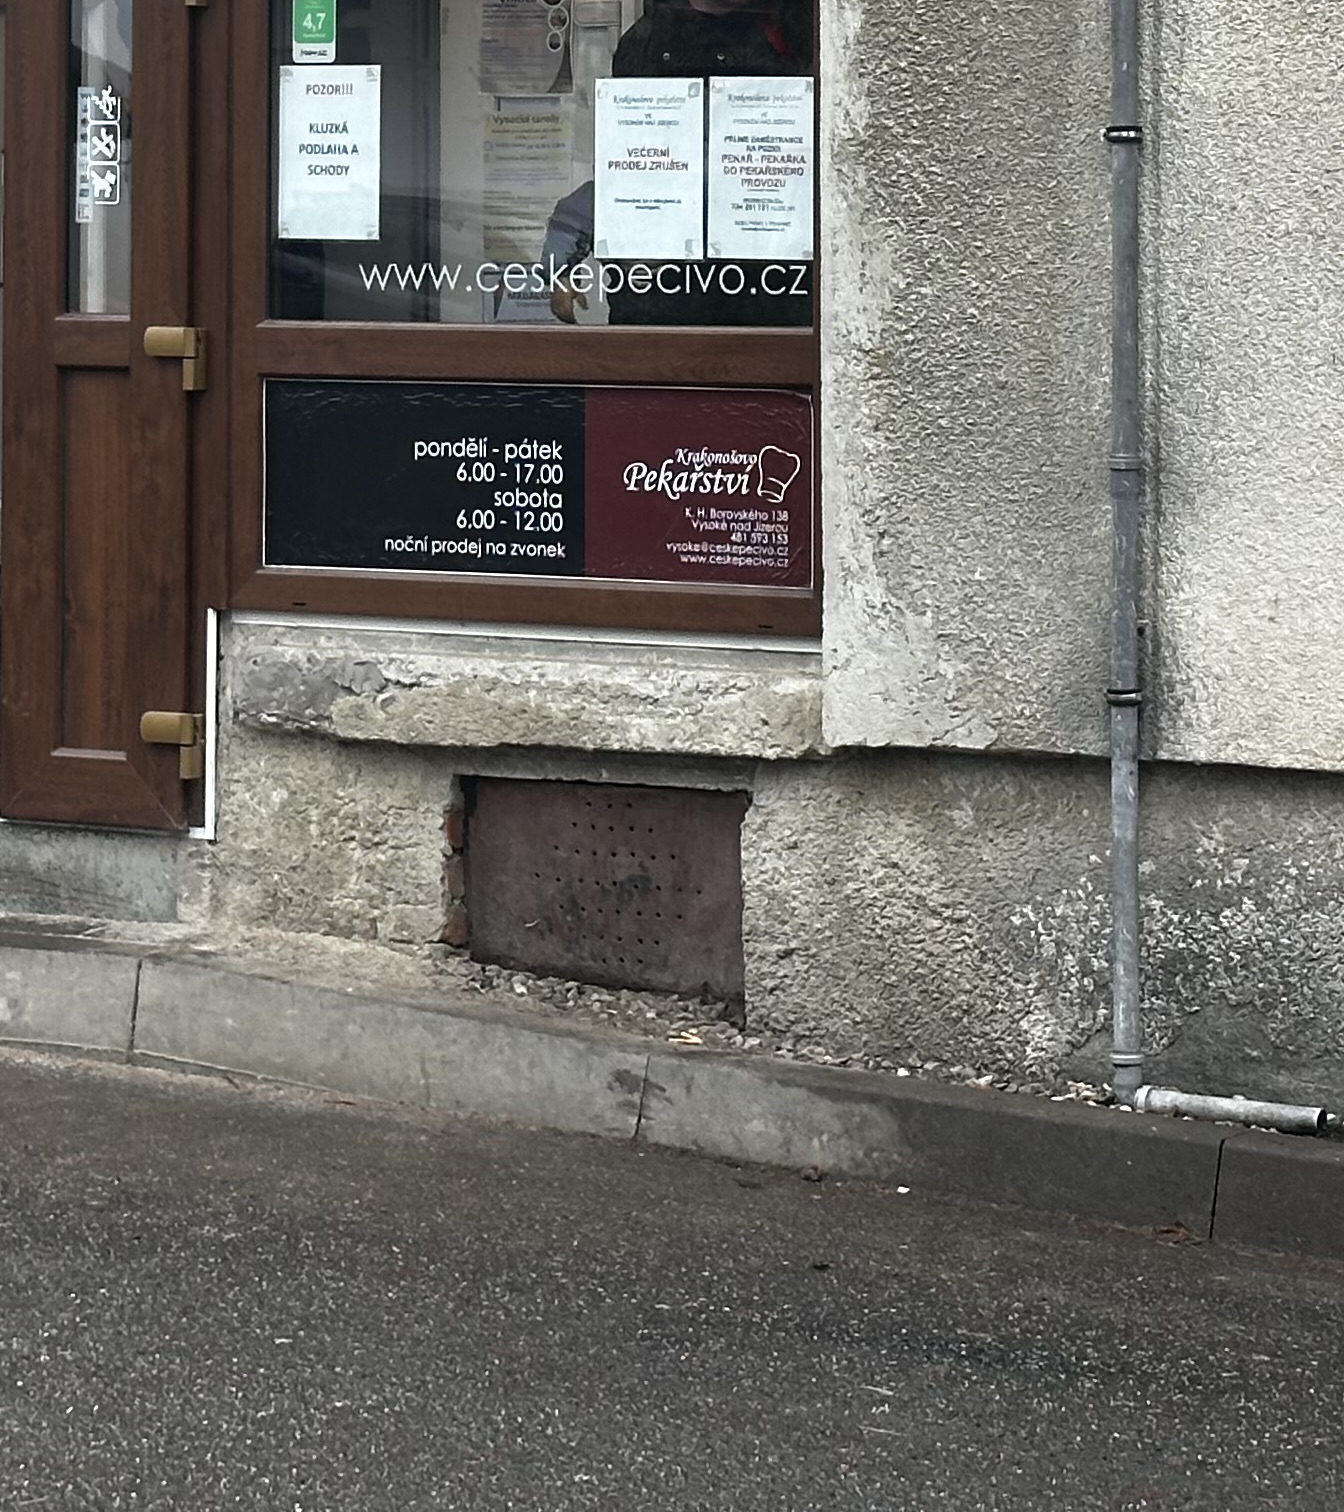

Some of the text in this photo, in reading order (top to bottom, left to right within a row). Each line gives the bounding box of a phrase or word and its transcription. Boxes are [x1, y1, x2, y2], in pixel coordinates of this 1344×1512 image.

[302, 12, 326, 32] 4,7
[306, 82, 354, 97] POZOR!!!
[308, 119, 349, 135] KLUZKÁ
[350, 143, 359, 155] A
[626, 144, 670, 158] VEČERNÍ
[306, 163, 351, 177] SCHODY
[607, 159, 647, 172] PRODEJ
[358, 256, 810, 301] www.ceskepecivo.cz
[414, 436, 488, 461] pondělí
[504, 437, 563, 463] pátek
[674, 446, 758, 468] Krakonošovo
[456, 461, 495, 482] 6.00
[513, 463, 564, 485] 17.00
[623, 458, 754, 500] Pekařství
[494, 487, 563, 509] sobota
[456, 509, 495, 530] 6.00
[513, 510, 564, 532] 12.00
[710, 507, 769, 522] Borovského
[771, 510, 789, 522] 138
[691, 518, 789, 534] Vysoké nad Jizerou
[384, 535, 566, 559] noční prodej na zvonek
[680, 553, 789, 568] www.ceskepecivo.cz
